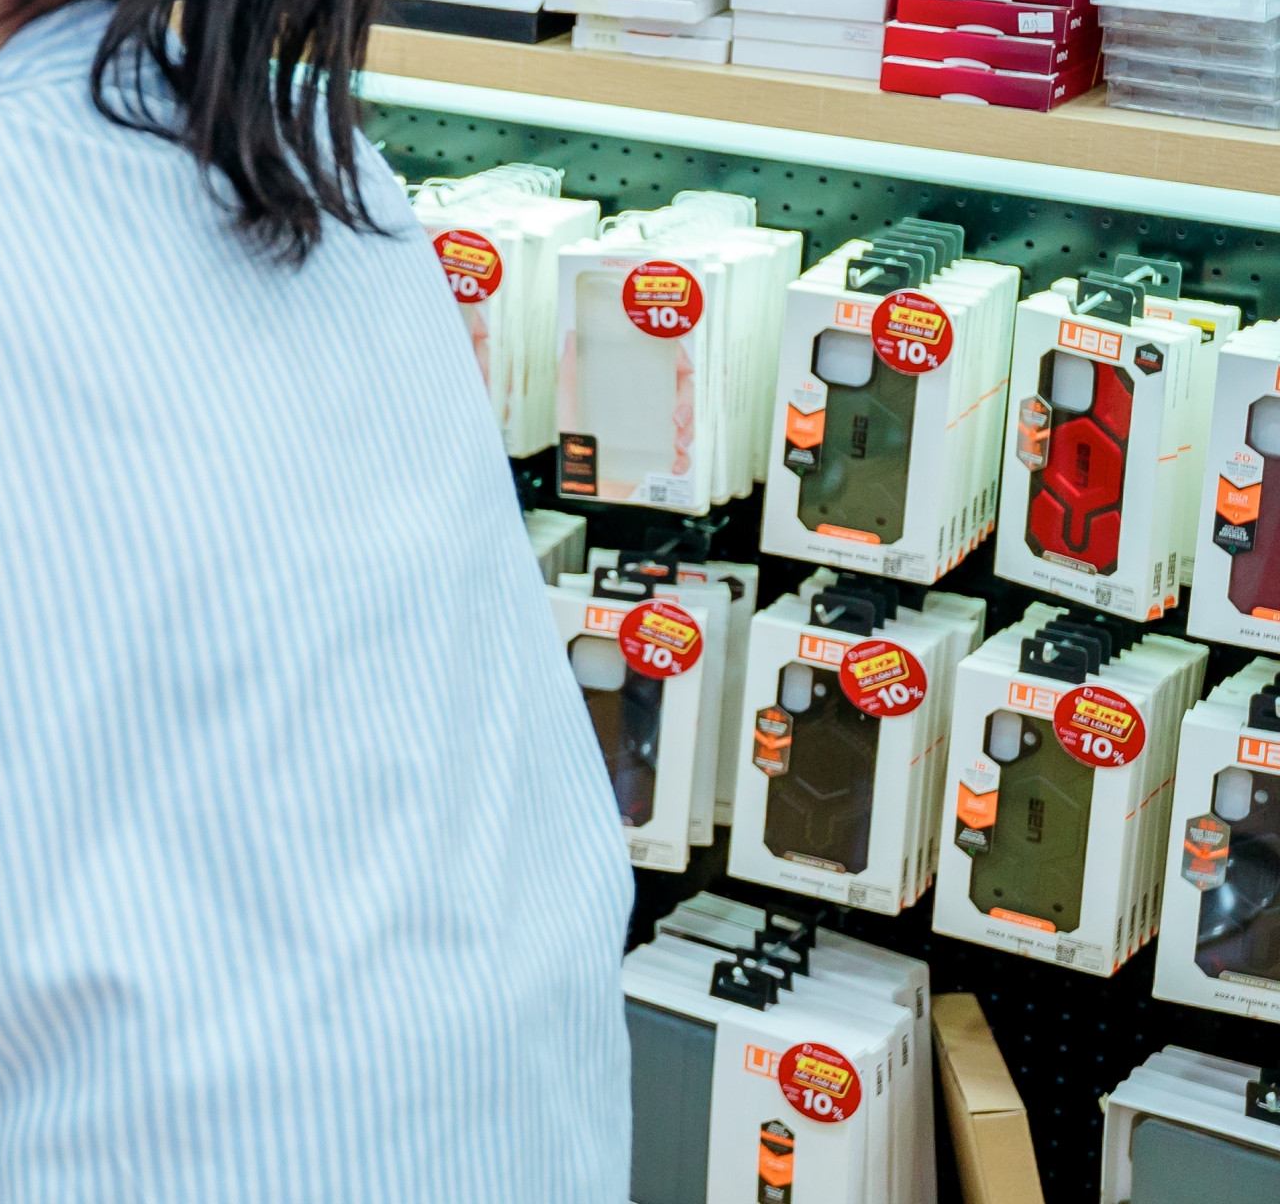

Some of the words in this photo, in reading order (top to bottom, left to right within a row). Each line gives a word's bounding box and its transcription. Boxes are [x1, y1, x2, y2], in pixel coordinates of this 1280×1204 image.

[647, 306, 691, 329] 10%
[897, 339, 938, 368] 10%
[1061, 322, 1120, 359] UAG
[642, 643, 683, 673] 10%
[877, 683, 924, 708] 10%
[1080, 732, 1125, 765] 10%
[802, 1088, 844, 1120] 10%
